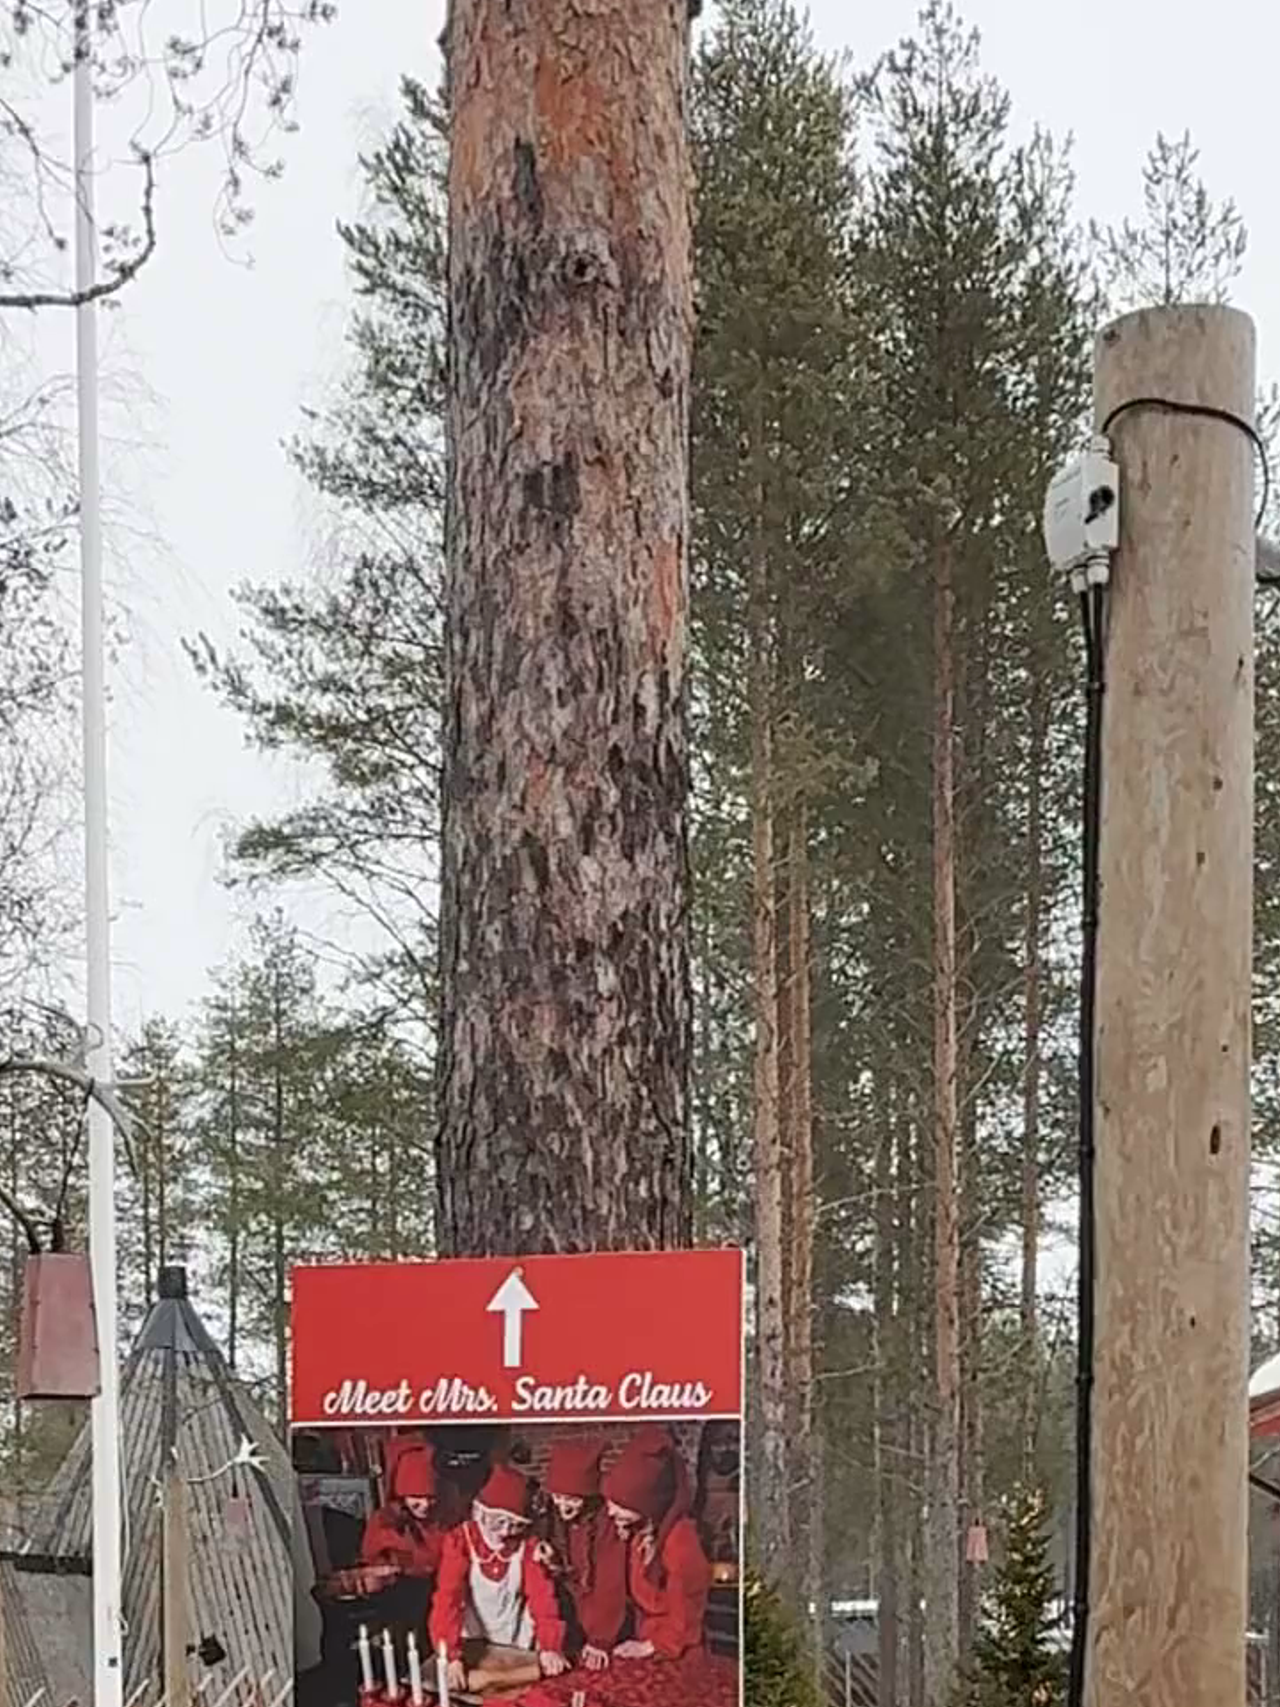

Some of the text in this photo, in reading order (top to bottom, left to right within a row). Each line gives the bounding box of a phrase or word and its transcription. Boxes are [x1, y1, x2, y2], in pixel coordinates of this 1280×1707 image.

[323, 1371, 712, 1415] Meet Mrs. Santa Claus
